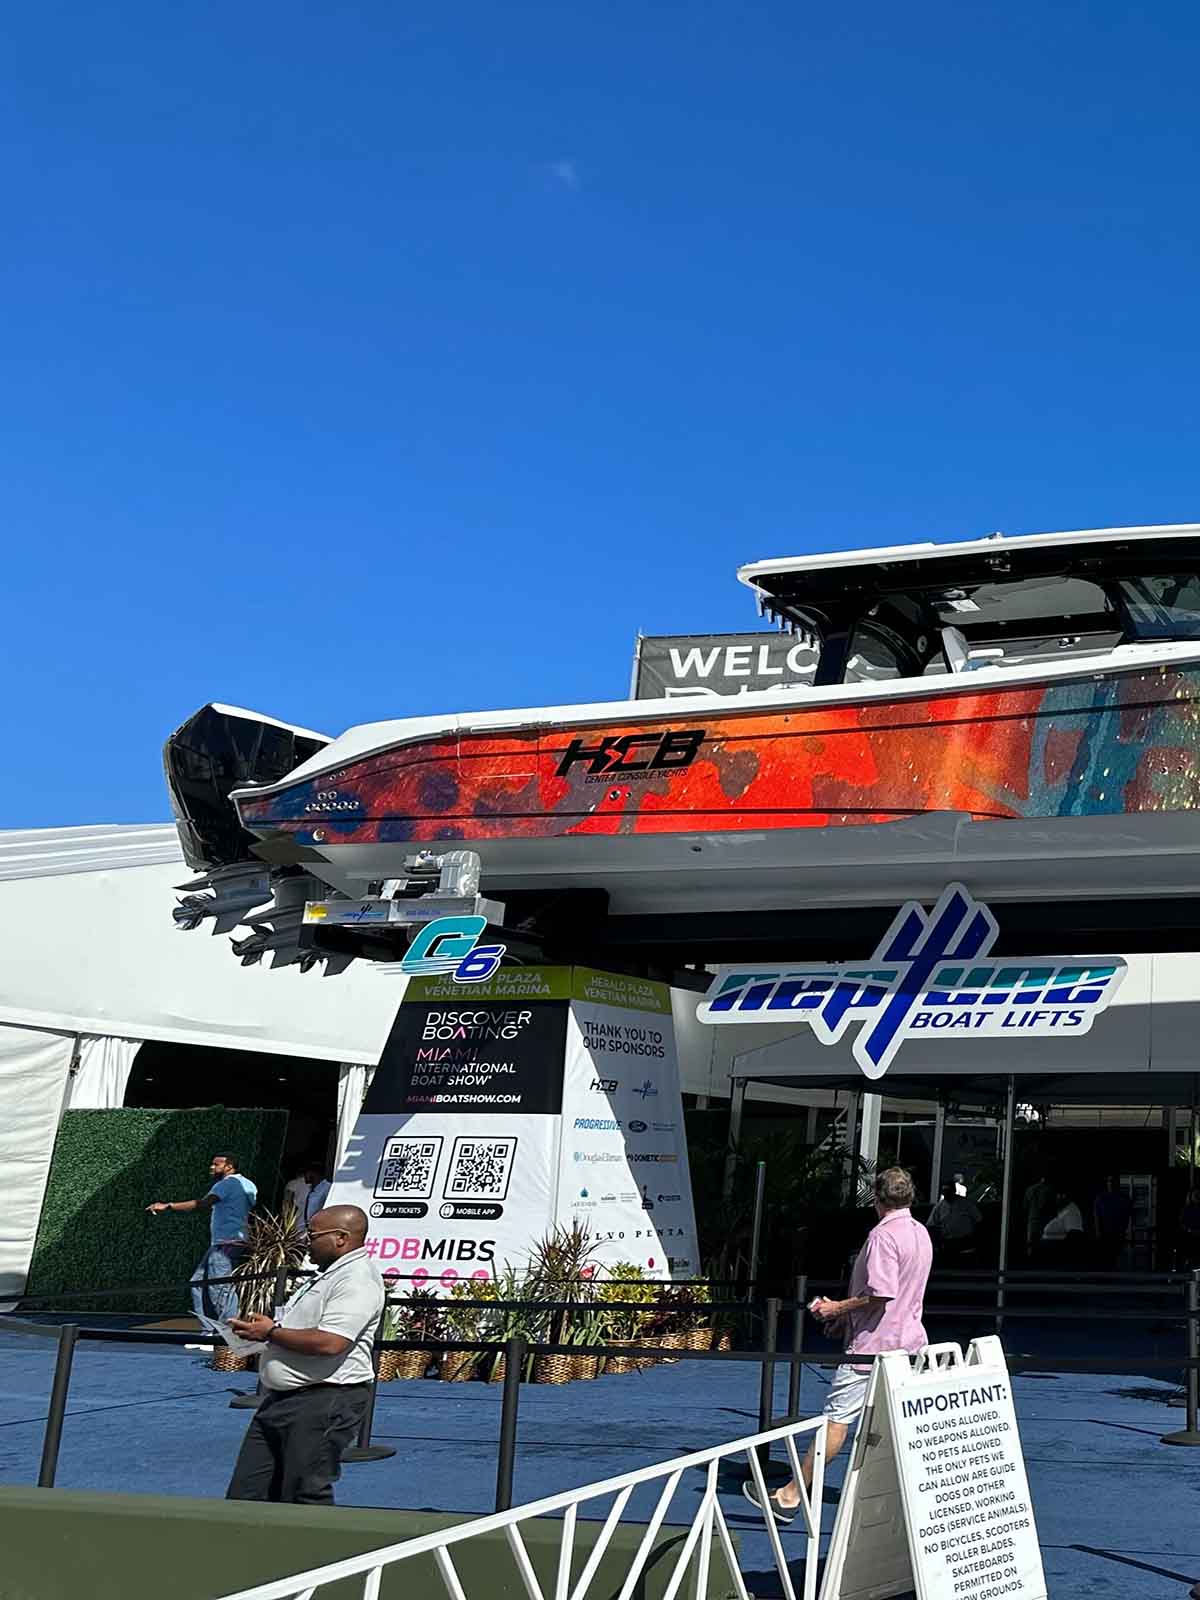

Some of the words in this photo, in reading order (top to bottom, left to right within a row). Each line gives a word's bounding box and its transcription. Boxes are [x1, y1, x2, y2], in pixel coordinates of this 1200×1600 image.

[669, 641, 821, 679] WELC
[618, 770, 657, 781] CONSOLE
[497, 973, 541, 984] PLAZA
[424, 984, 492, 997] VENETIAN
[496, 983, 551, 996] MARINA
[426, 1011, 532, 1026] DISCOVER
[909, 1011, 993, 1029] BOAT
[1001, 1010, 1084, 1027] LIFTS
[584, 1021, 622, 1039] THANK
[624, 1026, 646, 1041] YOU
[648, 1031, 663, 1044] TO
[416, 1048, 479, 1061] MIAMI
[583, 1036, 606, 1051] OUR
[608, 1040, 665, 1058] SPONSORS
[414, 1063, 516, 1073] INTERNATIONAL
[411, 1075, 444, 1086] BOAT
[407, 1094, 521, 1104] MIAMIBOATSHOW.COM
[573, 1118, 623, 1130] PROGRESSIVE
[582, 1231, 625, 1242] OLVO
[636, 1228, 684, 1239] PENTA
[366, 1237, 496, 1262] #DBMIBS
[902, 1384, 1007, 1418] IMPORTANT:
[916, 1424, 930, 1435] NO
[932, 1418, 957, 1431] GUNS
[909, 1440, 923, 1451] NO
[925, 1430, 968, 1447] WEAPONS
[922, 1452, 936, 1462] NO
[938, 1446, 960, 1459] PETS
[925, 1465, 943, 1476] THE
[945, 1459, 967, 1472] ONLY
[969, 1454, 990, 1466] PETS
[991, 1451, 1005, 1461] WE
[918, 1480, 938, 1492] CAN
[940, 1473, 970, 1488] ALLOW
[972, 1469, 988, 1480] ARE
[990, 1462, 1016, 1476] GUIDE
[935, 1490, 961, 1504] DOGS
[962, 1487, 975, 1497] OR
[977, 1480, 1005, 1494] OTHER
[929, 1502, 974, 1520] LICENSED,
[975, 1491, 1015, 1508] WORKING
[920, 1523, 946, 1538] DOGS
[947, 1513, 986, 1533] (SERVICE
[924, 1543, 939, 1554] NO
[941, 1531, 985, 1550] BICYCLES,
[945, 1547, 979, 1564] ROLLER
[952, 1552, 1015, 1578] SKATEBOARDS
[954, 1571, 1002, 1593] PERMITTED
[1004, 1566, 1018, 1578] ON
[980, 1579, 1025, 1600] GROUNDS.
